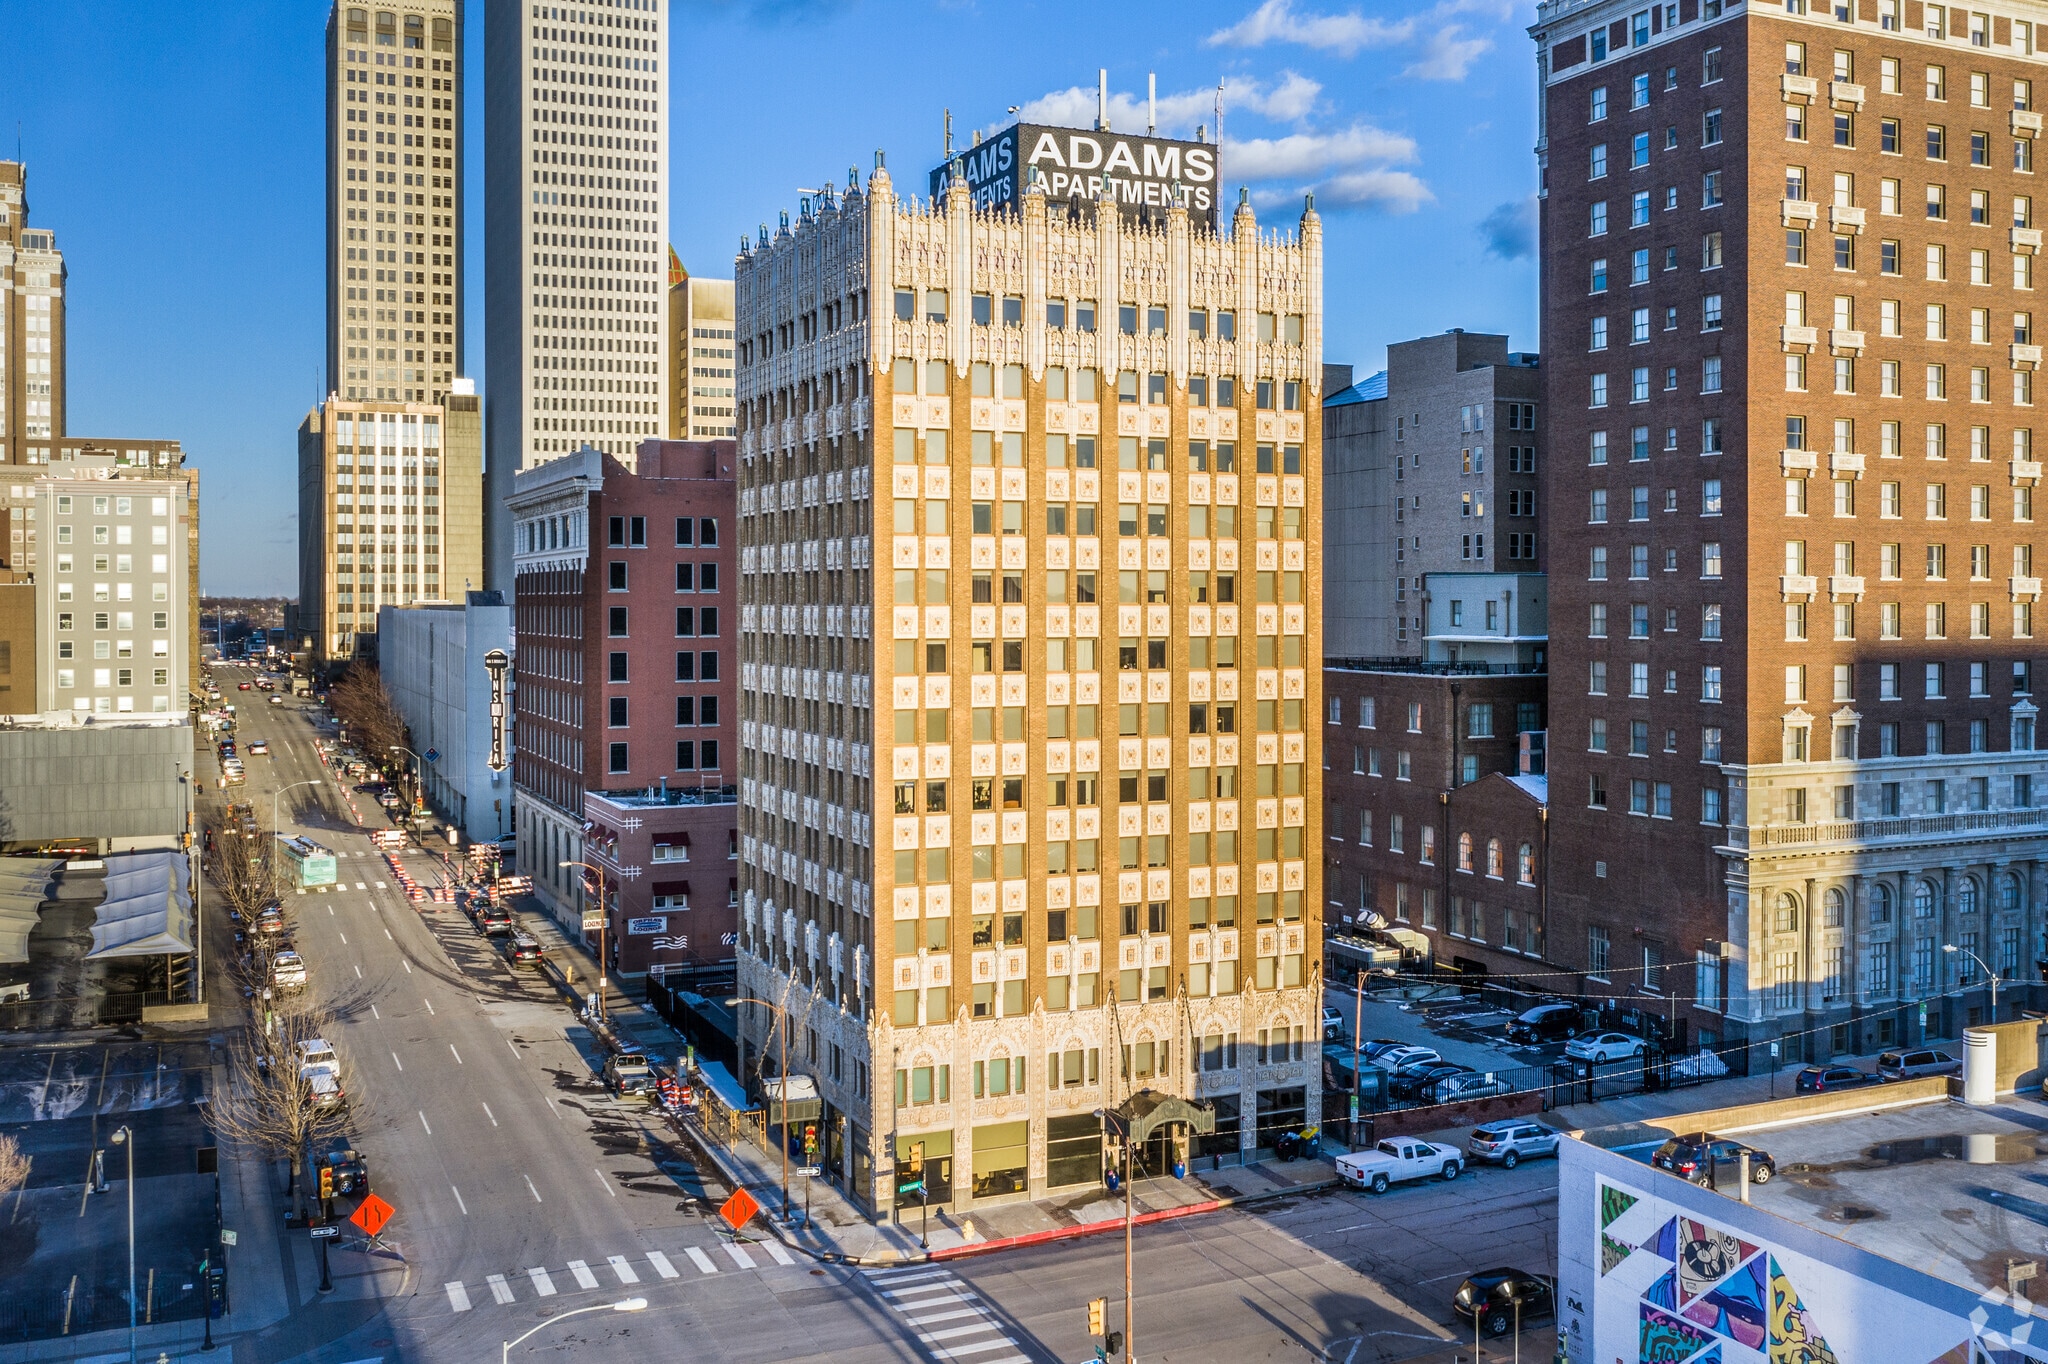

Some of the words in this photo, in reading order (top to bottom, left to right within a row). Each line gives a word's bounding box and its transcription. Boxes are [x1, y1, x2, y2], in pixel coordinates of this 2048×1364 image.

[936, 136, 1013, 205] AAMS
[1028, 132, 1215, 182] ADAMS
[1036, 170, 1211, 211] APARTMENTS
